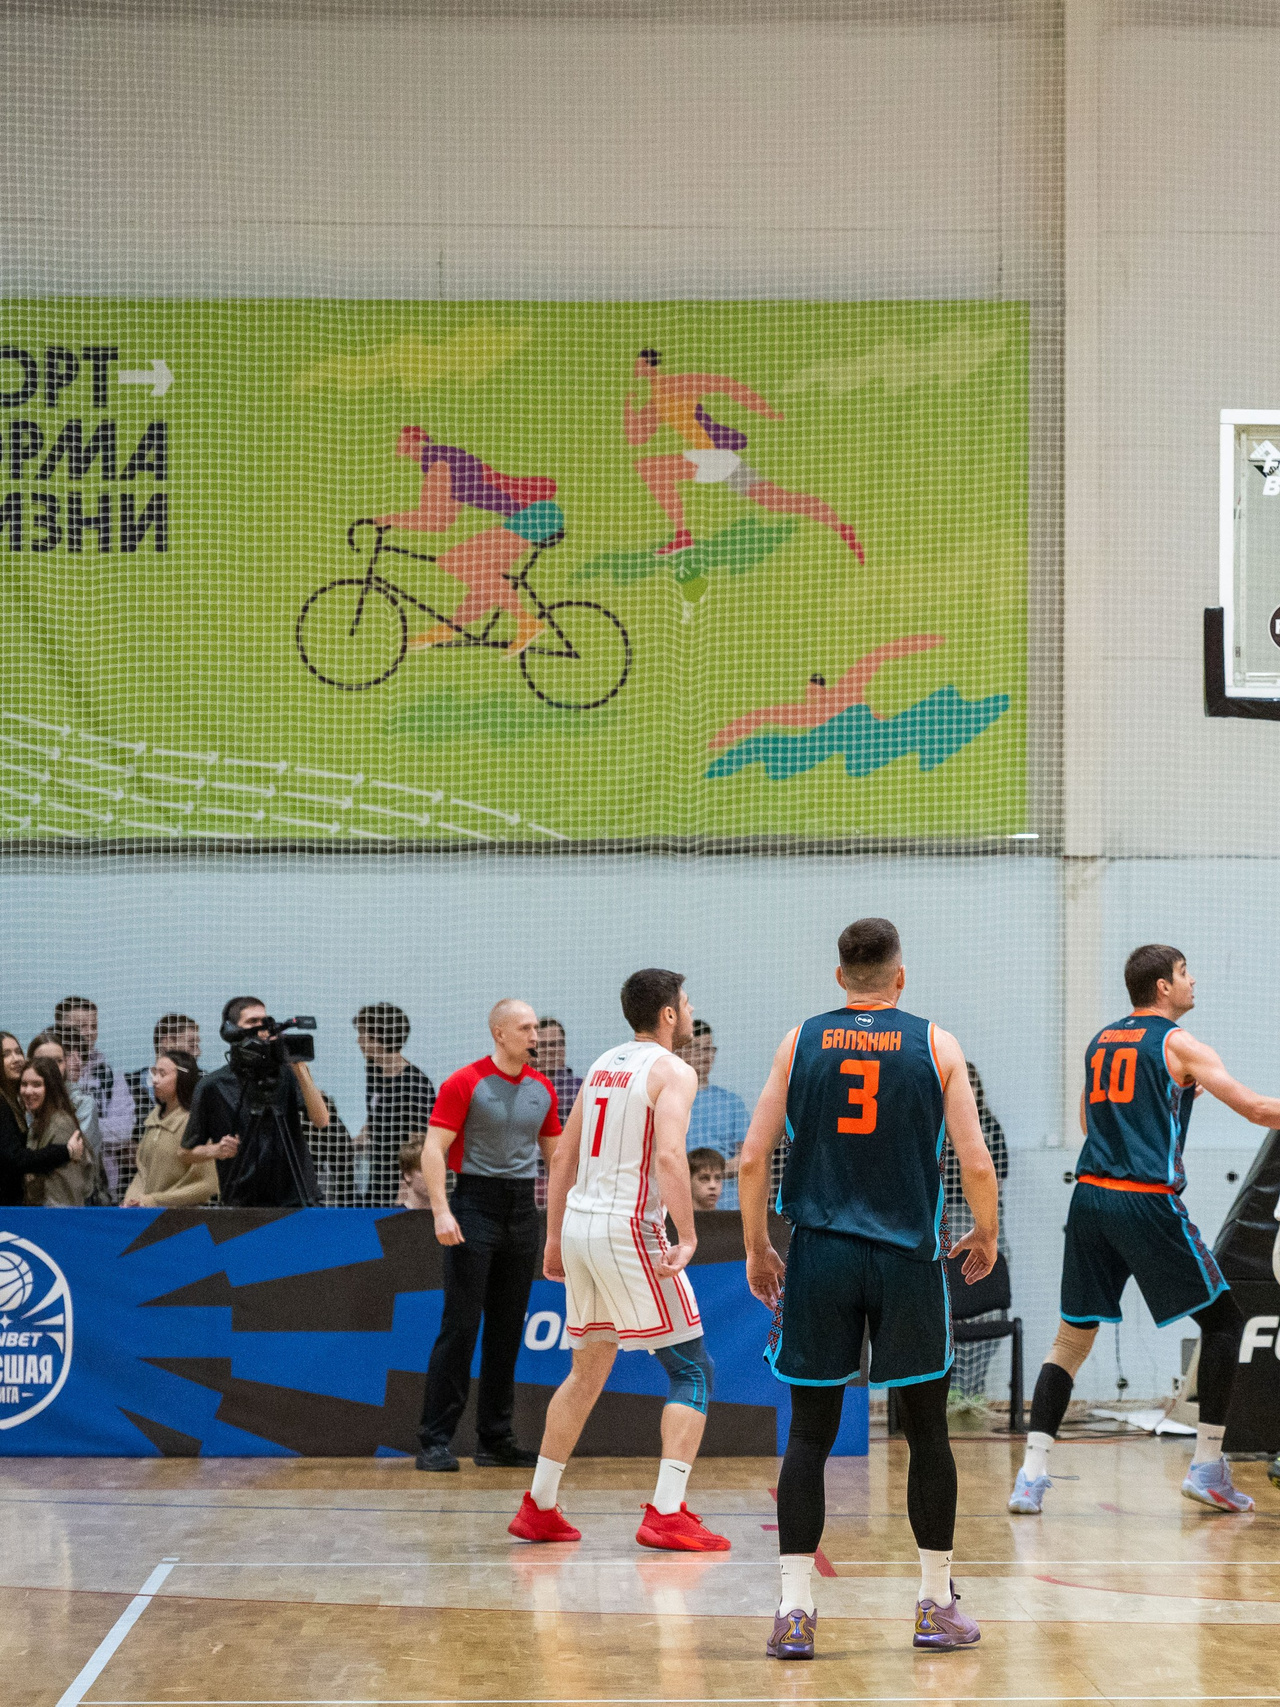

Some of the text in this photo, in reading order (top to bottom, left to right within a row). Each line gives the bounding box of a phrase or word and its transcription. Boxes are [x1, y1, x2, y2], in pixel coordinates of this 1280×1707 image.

[0, 419, 167, 481] РМА
[821, 1028, 902, 1052] БАЛЯКИН
[837, 1058, 880, 1135] 3
[1089, 1047, 1138, 1104] 10
[590, 1097, 609, 1158] 1
